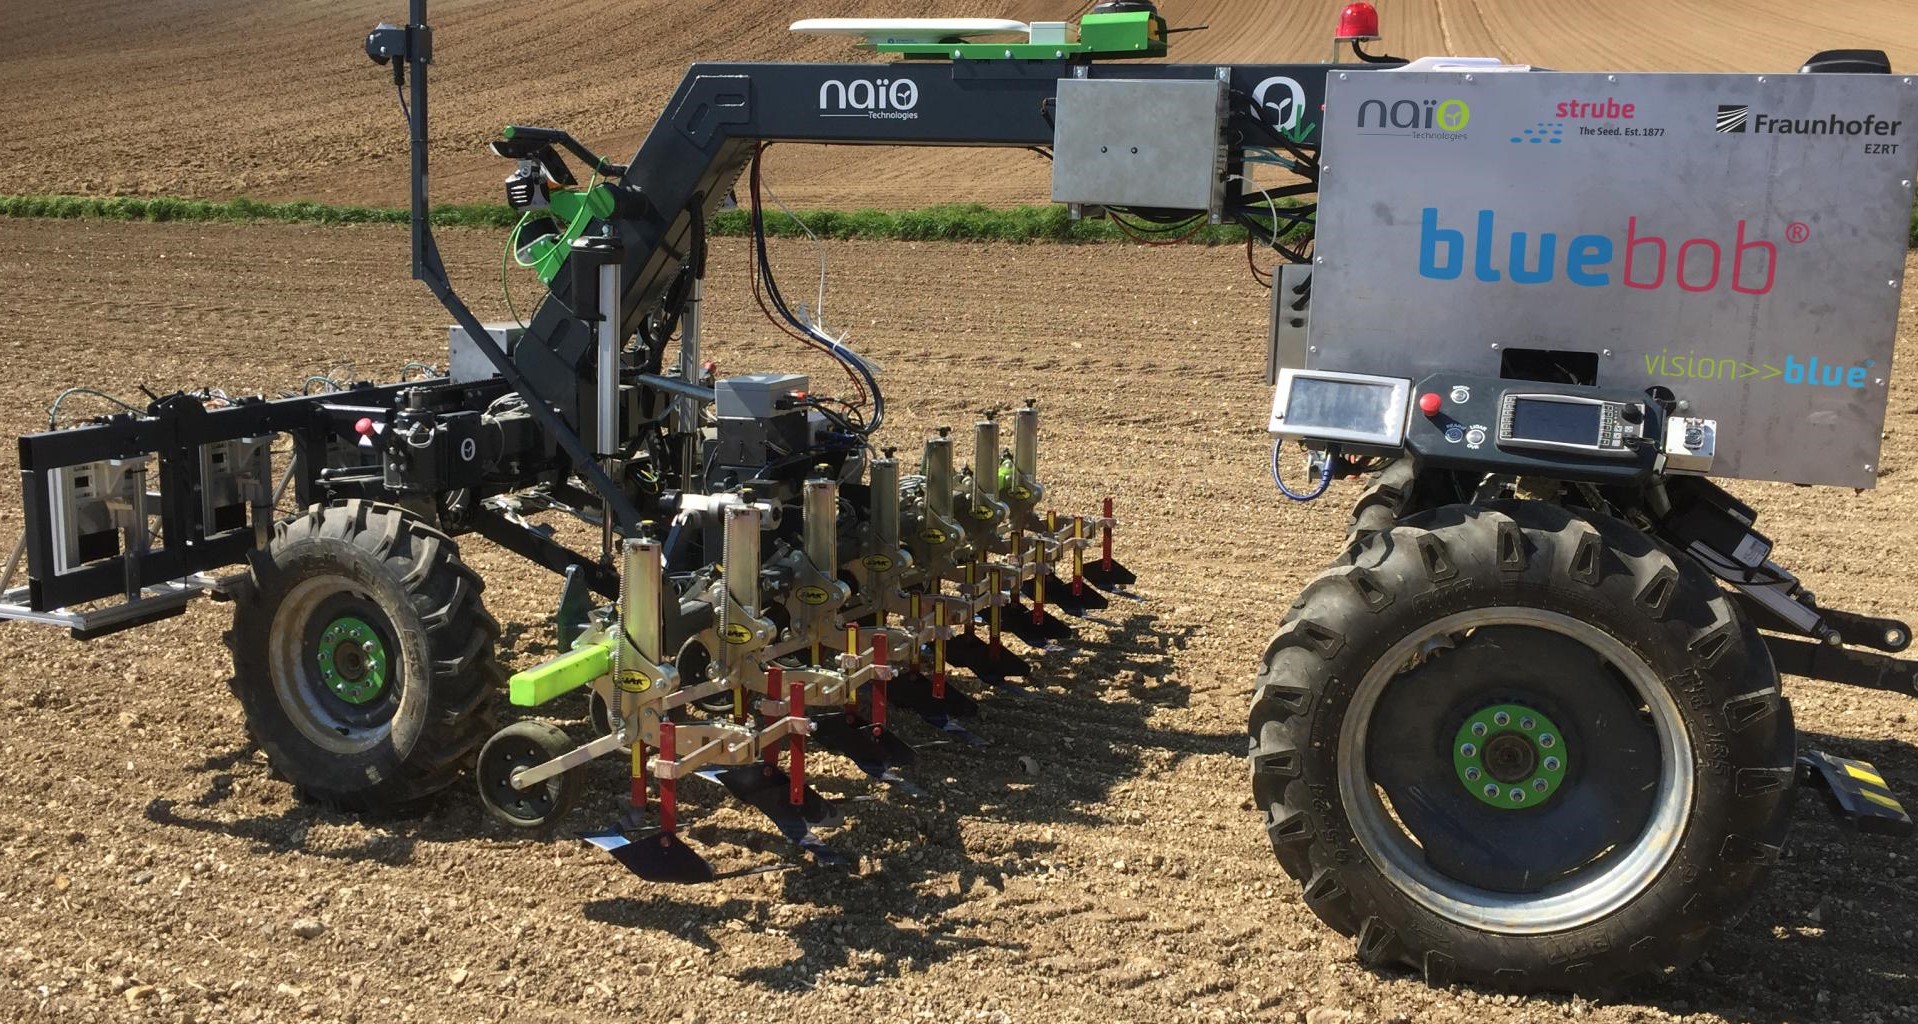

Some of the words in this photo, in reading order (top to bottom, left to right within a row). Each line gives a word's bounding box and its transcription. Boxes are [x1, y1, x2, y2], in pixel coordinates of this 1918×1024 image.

[1556, 97, 1636, 119] strube
[868, 110, 919, 121] Technologies
[1754, 113, 1902, 136] Fraunhofer
[1412, 131, 1468, 141] Technologies
[1579, 126, 1596, 136] The
[1597, 127, 1622, 136] Seed.
[1624, 127, 1641, 137] Est.
[1642, 128, 1665, 137] 1877
[1864, 143, 1899, 155] EZRT
